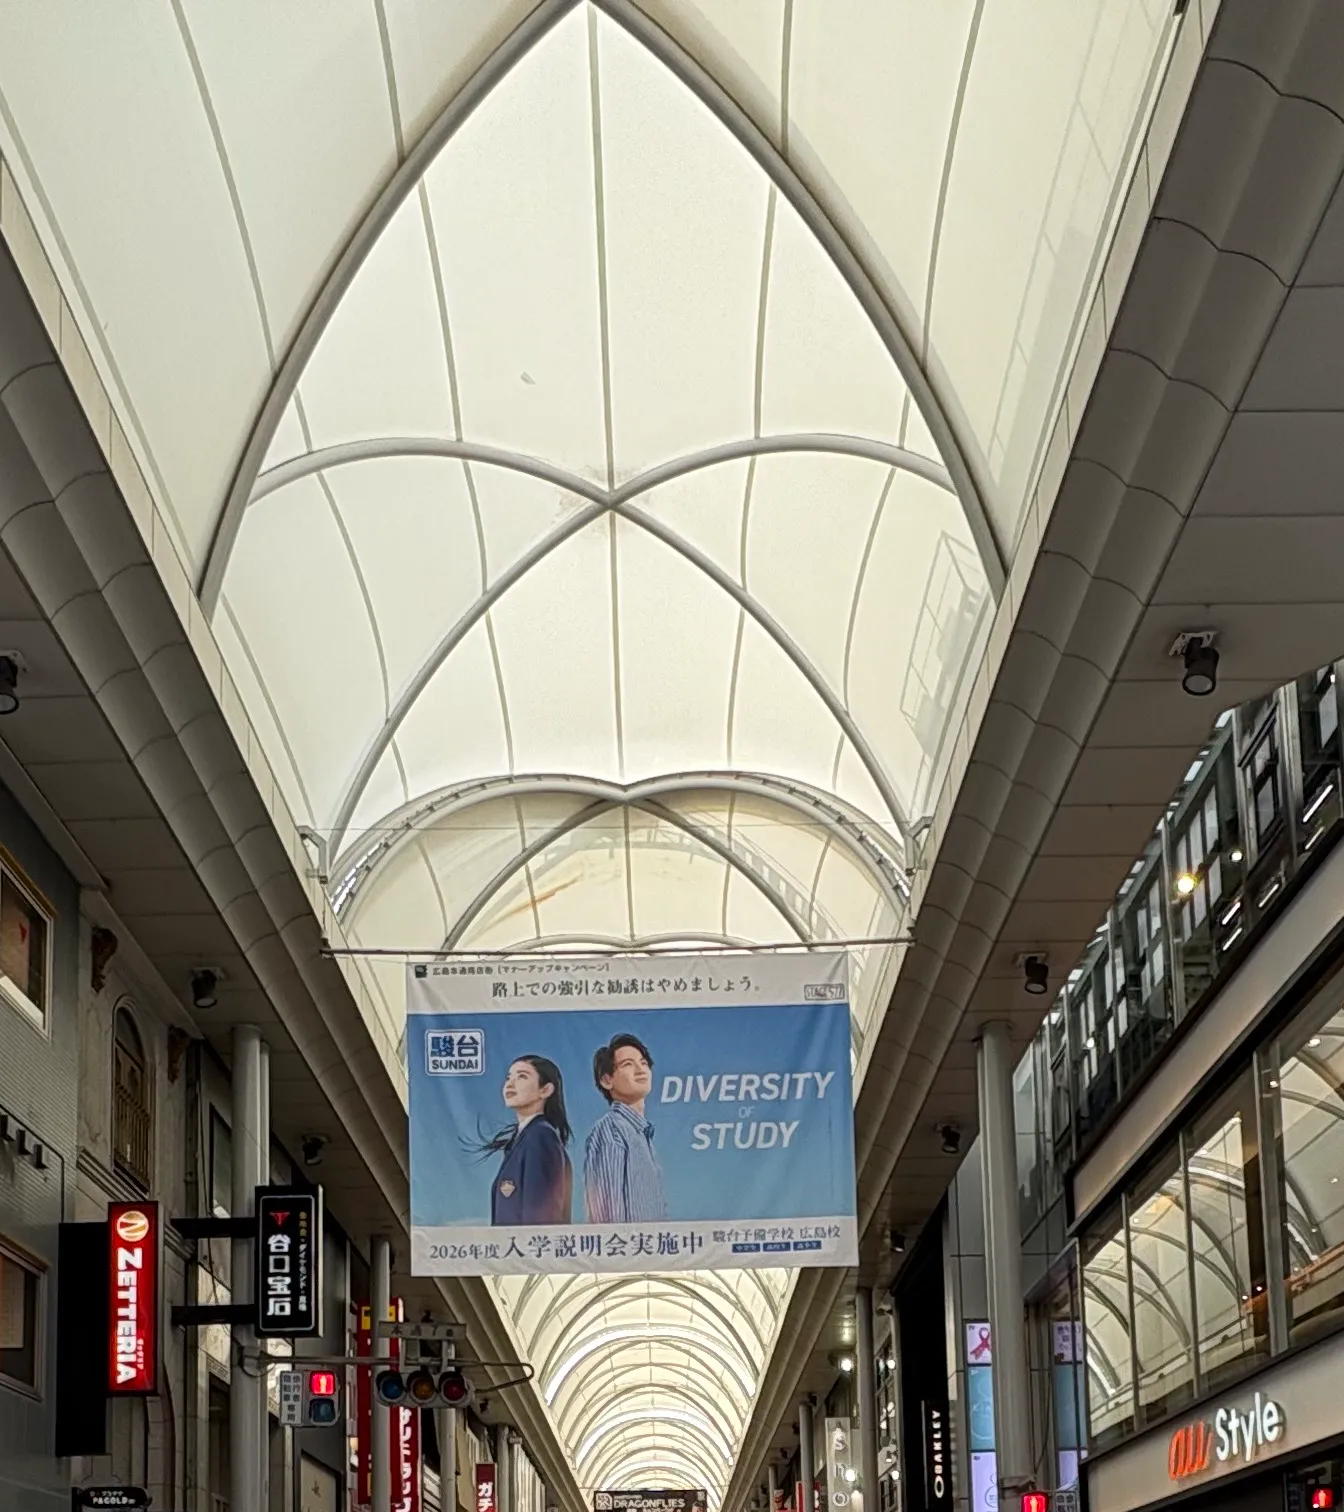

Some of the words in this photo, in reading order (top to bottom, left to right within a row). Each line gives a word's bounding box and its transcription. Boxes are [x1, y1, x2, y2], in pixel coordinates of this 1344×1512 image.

[492, 976, 760, 998] 路上での強引な勧誘はやめましょう。
[430, 1035, 480, 1058] 駿台
[432, 1059, 479, 1070] SUNDAI
[660, 1071, 835, 1104] DIVERSITY
[738, 1105, 755, 1119] OF
[690, 1120, 800, 1152] STUDY
[799, 1225, 841, 1240] 広島校
[267, 1234, 291, 1316] 谷口宝石
[116, 1247, 143, 1385] ZETTERIA
[1168, 1420, 1213, 1481] au
[1215, 1392, 1283, 1461] Style
[932, 1409, 945, 1499] OAKLEY
[613, 1498, 685, 1509] DRAGONFLIES
